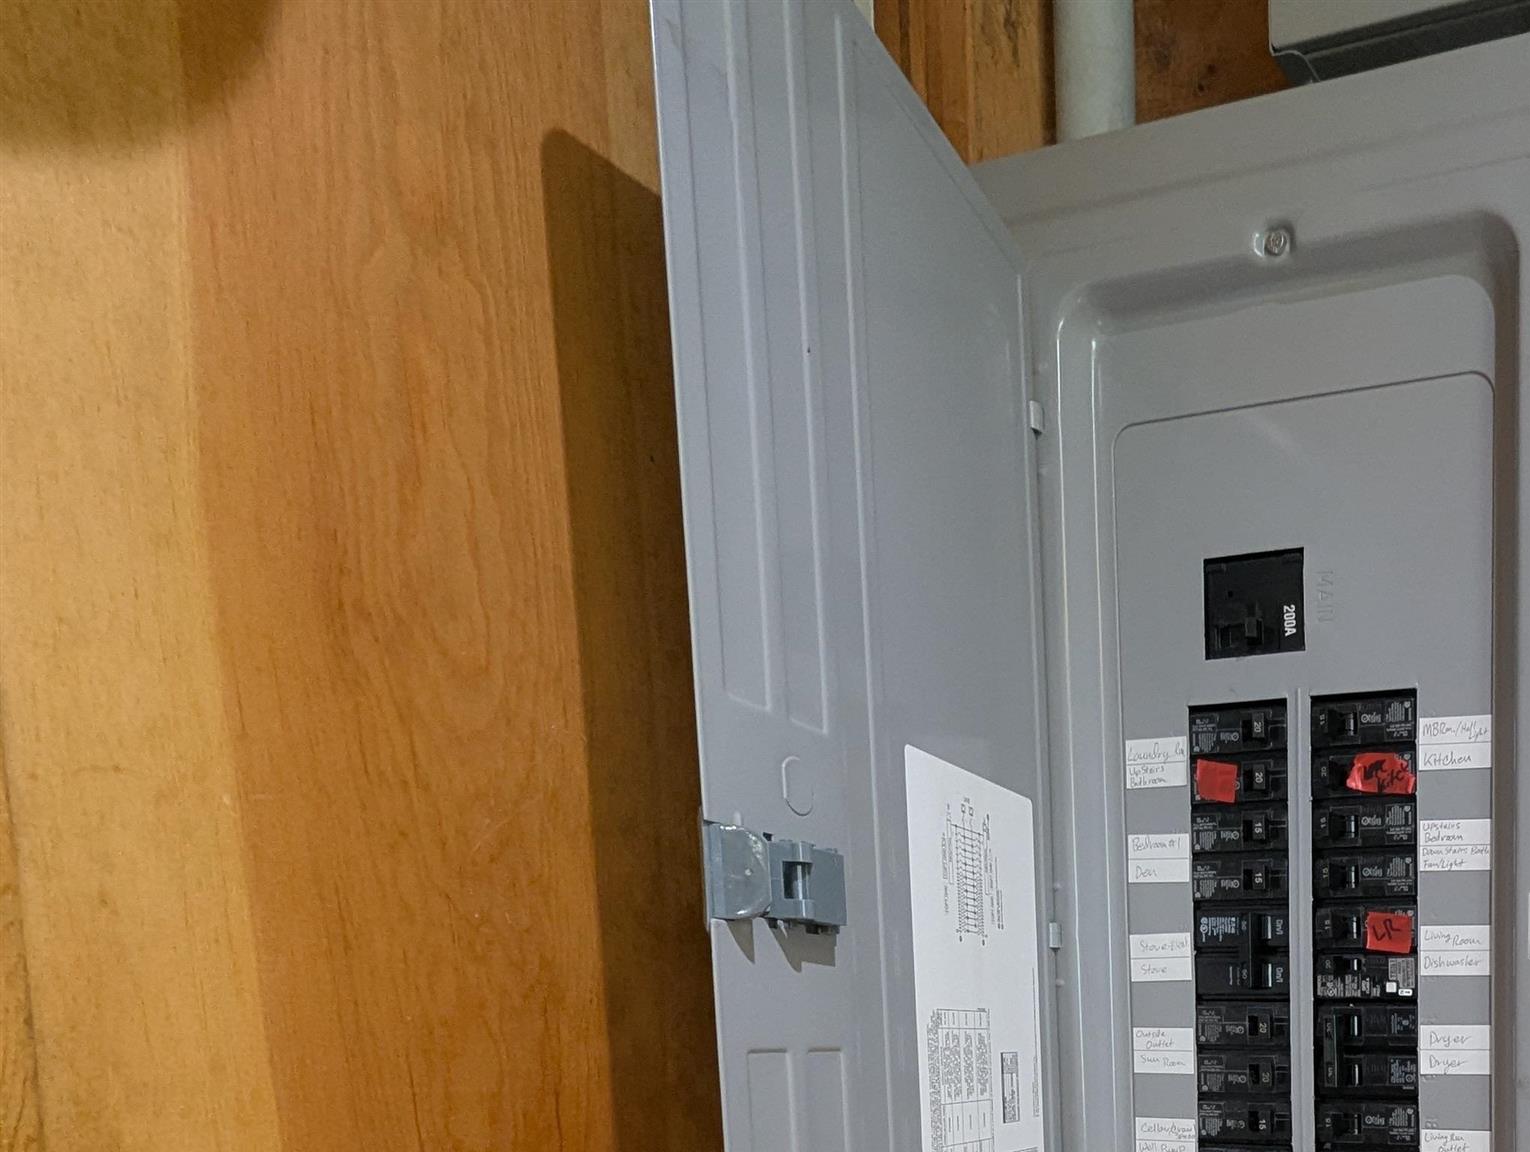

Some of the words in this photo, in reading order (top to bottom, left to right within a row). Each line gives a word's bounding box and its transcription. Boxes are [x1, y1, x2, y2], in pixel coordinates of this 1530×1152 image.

[1283, 604, 1297, 637] 200A
[1254, 721, 1262, 733] 20
[1424, 751, 1472, 767] Kitchen
[1254, 771, 1263, 784] 20
[1254, 822, 1263, 834] 15
[1135, 865, 1158, 878] Den
[1254, 872, 1263, 884] 15
[1372, 918, 1402, 944] LR
[1424, 929, 1452, 944] Living
[1259, 1022, 1268, 1034] 20
[1429, 1030, 1472, 1046] Dryer
[1429, 1053, 1469, 1074] Dryer
[1261, 1071, 1270, 1083] 20
[1258, 1119, 1267, 1130] 15
